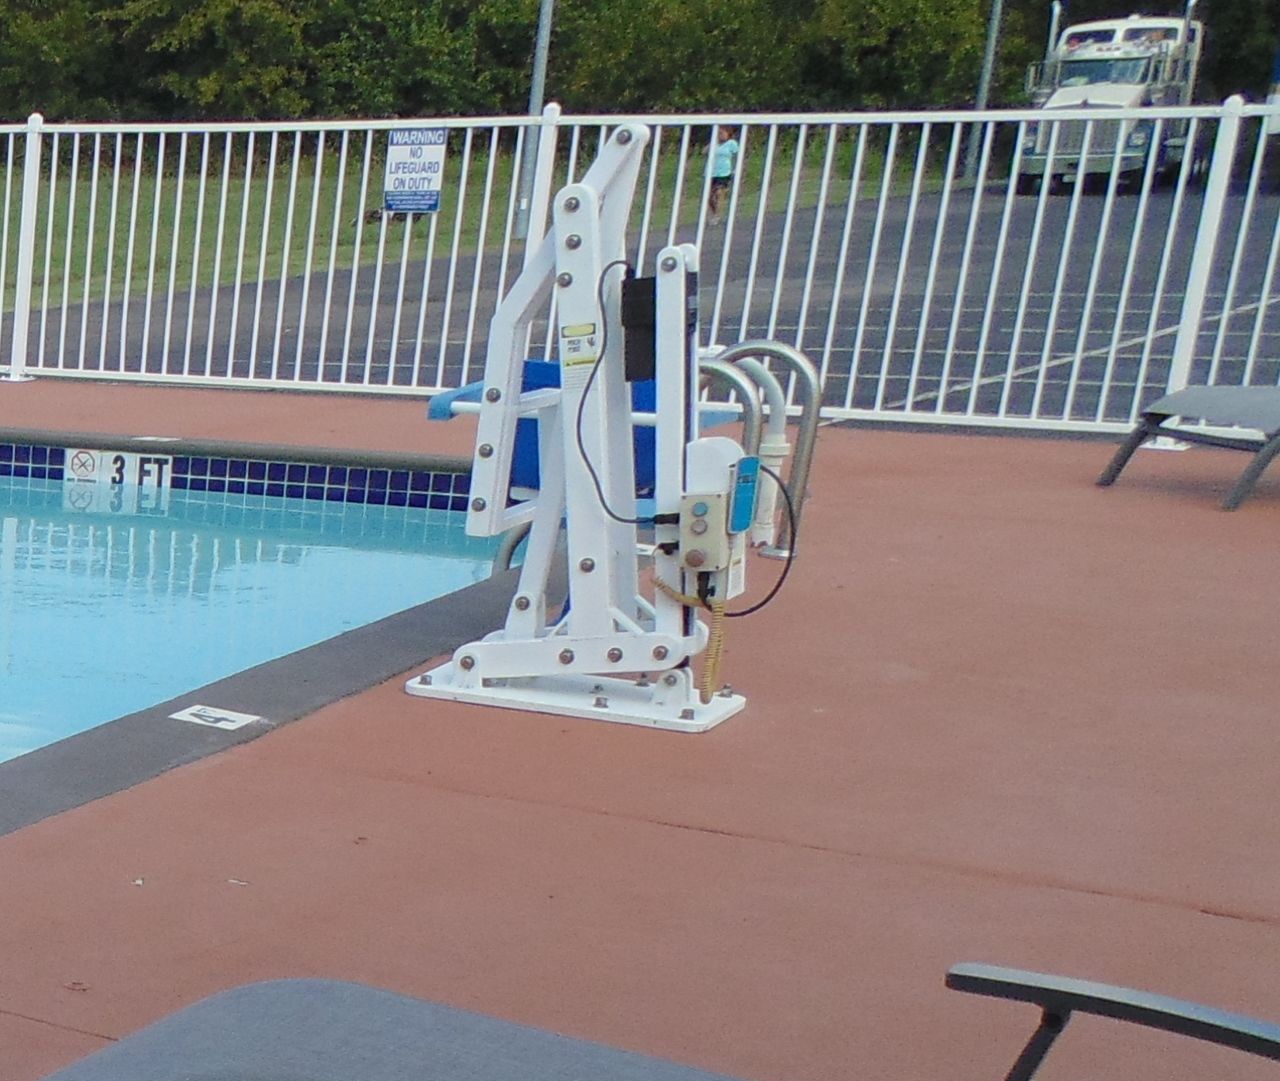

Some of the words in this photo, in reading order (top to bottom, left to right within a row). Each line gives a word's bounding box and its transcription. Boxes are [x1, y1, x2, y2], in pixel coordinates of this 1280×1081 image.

[392, 131, 444, 144] WARNING
[409, 147, 423, 159] NO
[389, 161, 440, 175] LIFEGUARD
[393, 177, 406, 189] ON
[408, 177, 433, 189] DUTY
[111, 454, 125, 484] 3
[138, 457, 169, 488] FT
